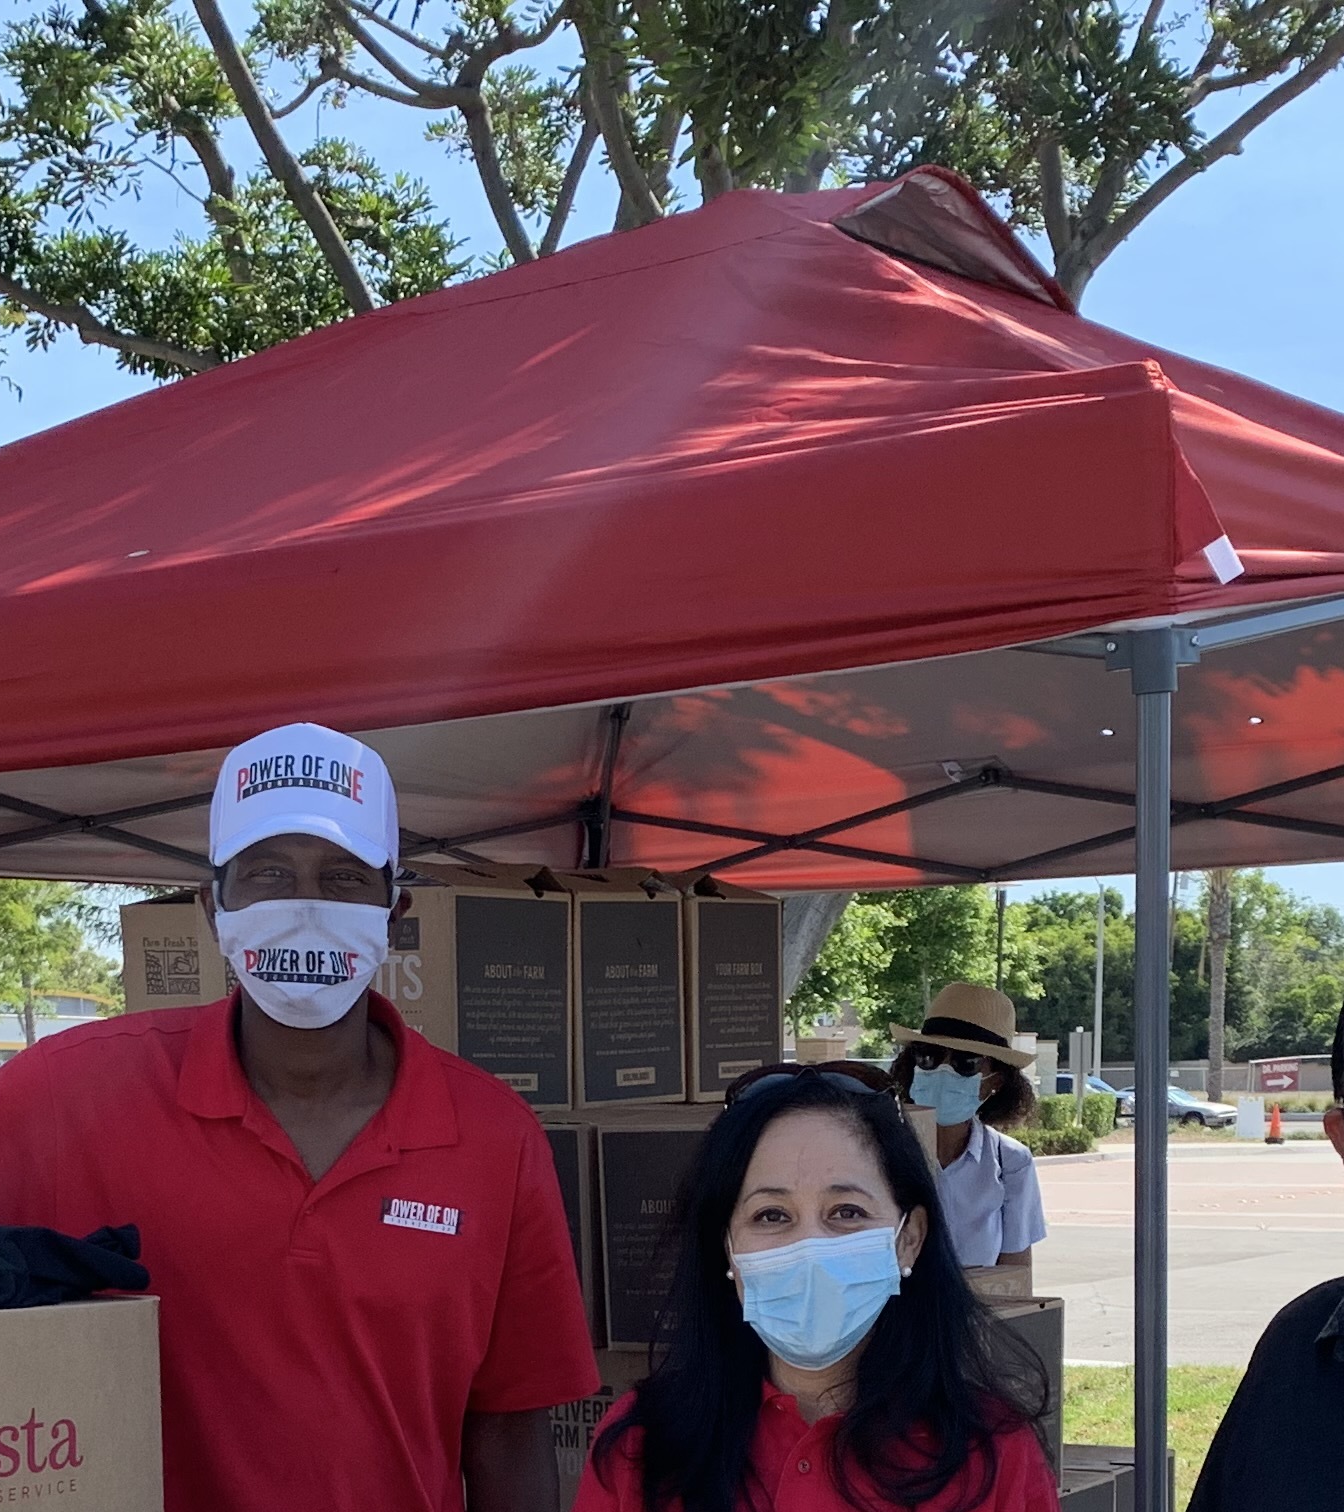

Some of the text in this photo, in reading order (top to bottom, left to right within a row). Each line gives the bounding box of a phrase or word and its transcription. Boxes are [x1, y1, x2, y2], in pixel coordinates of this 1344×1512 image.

[237, 754, 364, 805] POWER OF ONE
[244, 949, 300, 973] POWER
[306, 950, 325, 973] OF
[484, 964, 513, 979] ABOUT
[524, 965, 545, 980] FARM
[605, 964, 630, 979] ABOUT
[426, 1204, 442, 1223] OF
